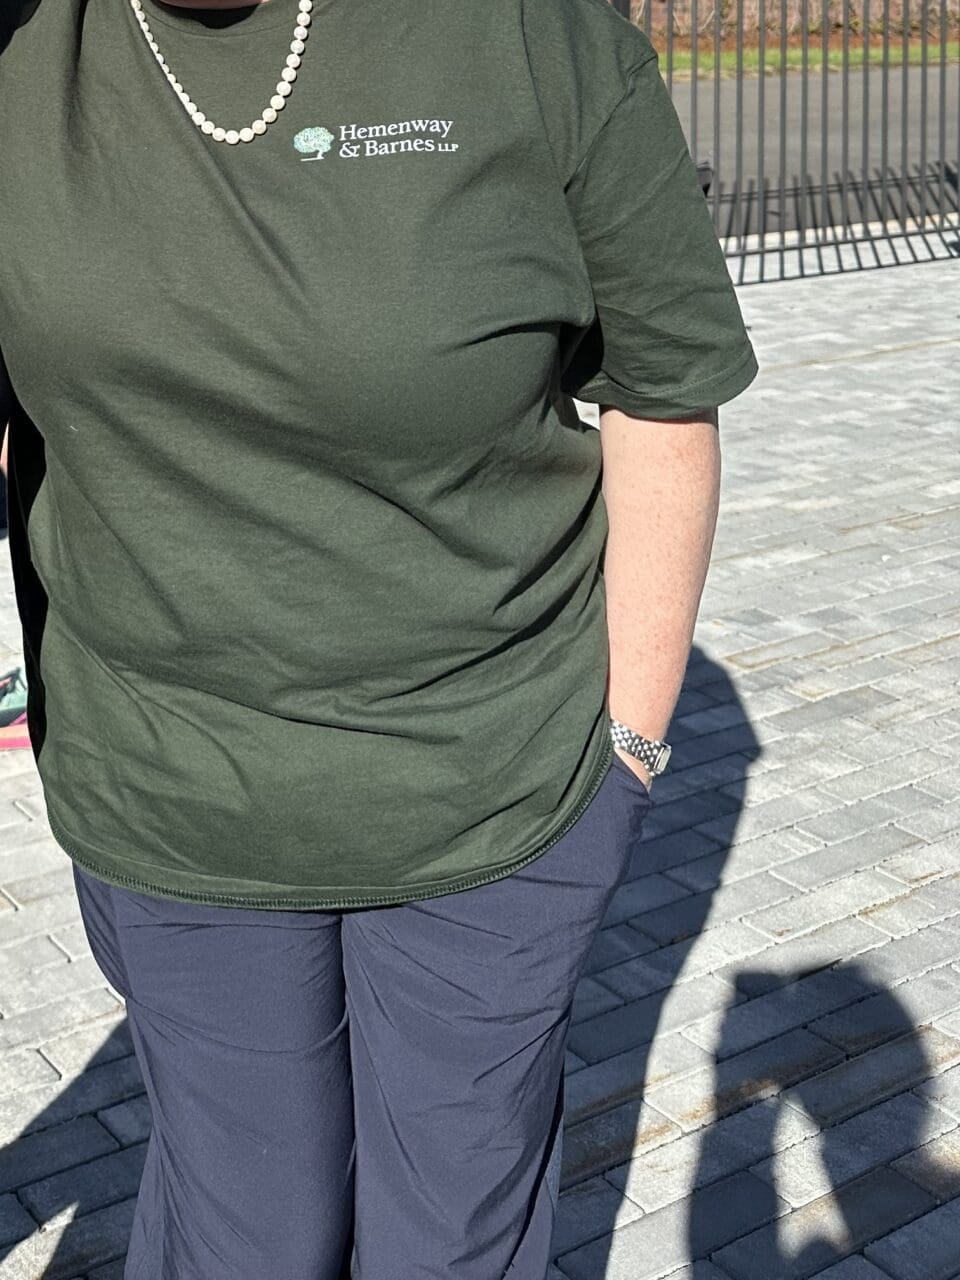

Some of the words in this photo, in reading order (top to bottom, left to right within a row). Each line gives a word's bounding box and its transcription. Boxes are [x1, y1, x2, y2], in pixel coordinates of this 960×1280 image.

[339, 119, 454, 141] Hemenway
[339, 141, 361, 158] &
[364, 138, 435, 157] Barnes
[438, 143, 459, 153] LLP
